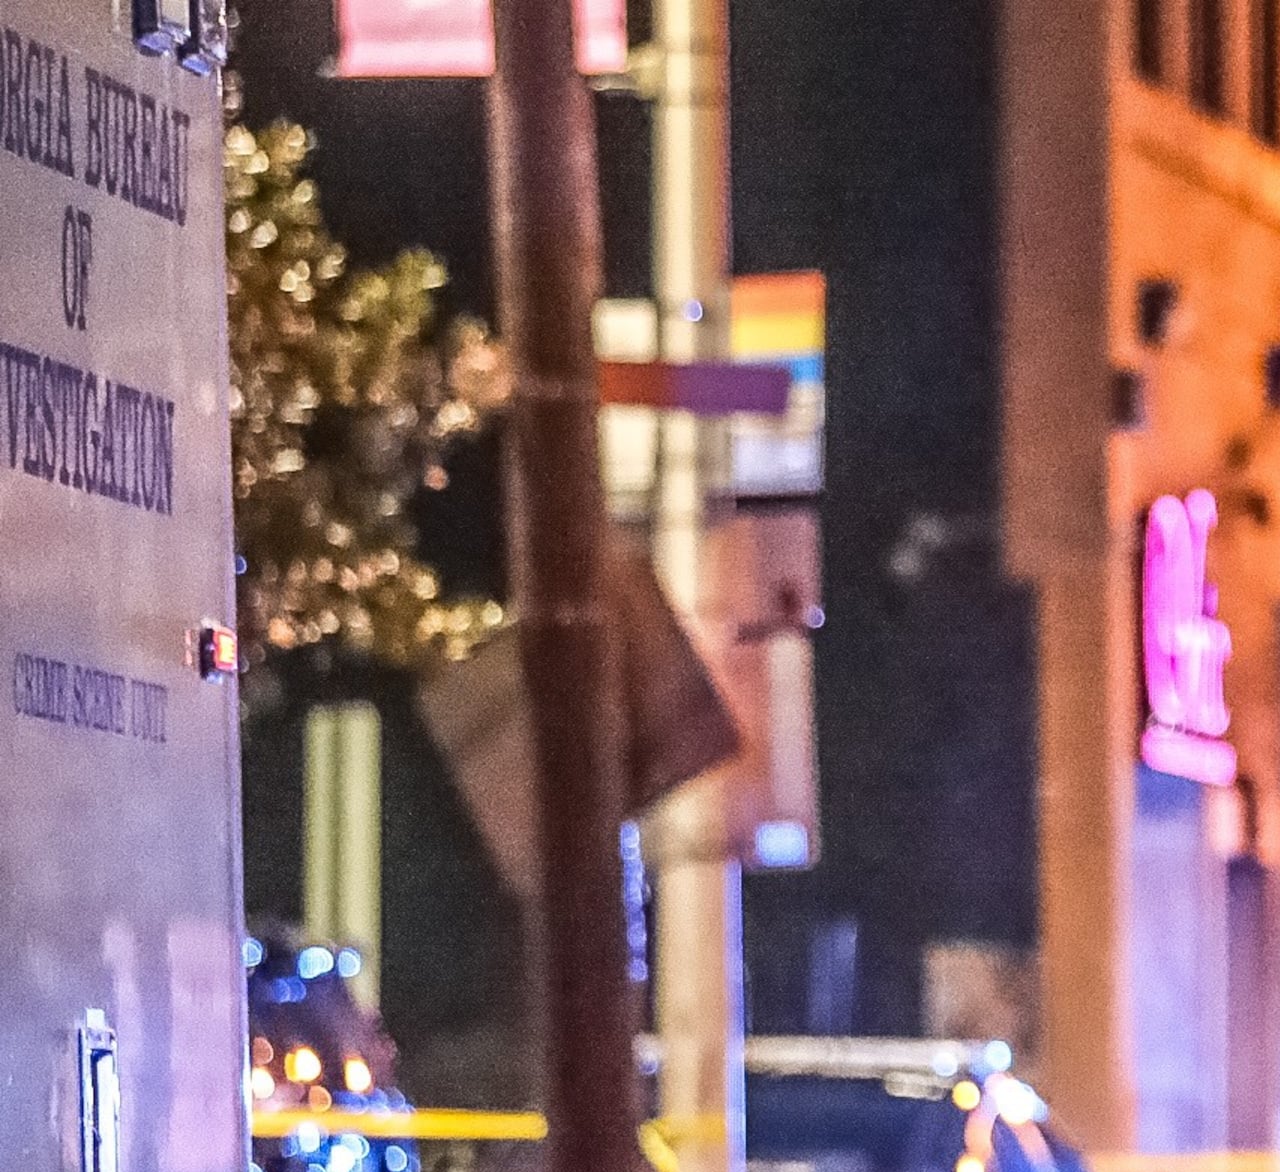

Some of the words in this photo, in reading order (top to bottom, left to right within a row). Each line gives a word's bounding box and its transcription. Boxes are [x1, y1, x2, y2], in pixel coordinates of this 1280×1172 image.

[85, 67, 190, 227] BUREAU
[62, 204, 92, 331] OF
[0, 342, 174, 516] VESTIGATION
